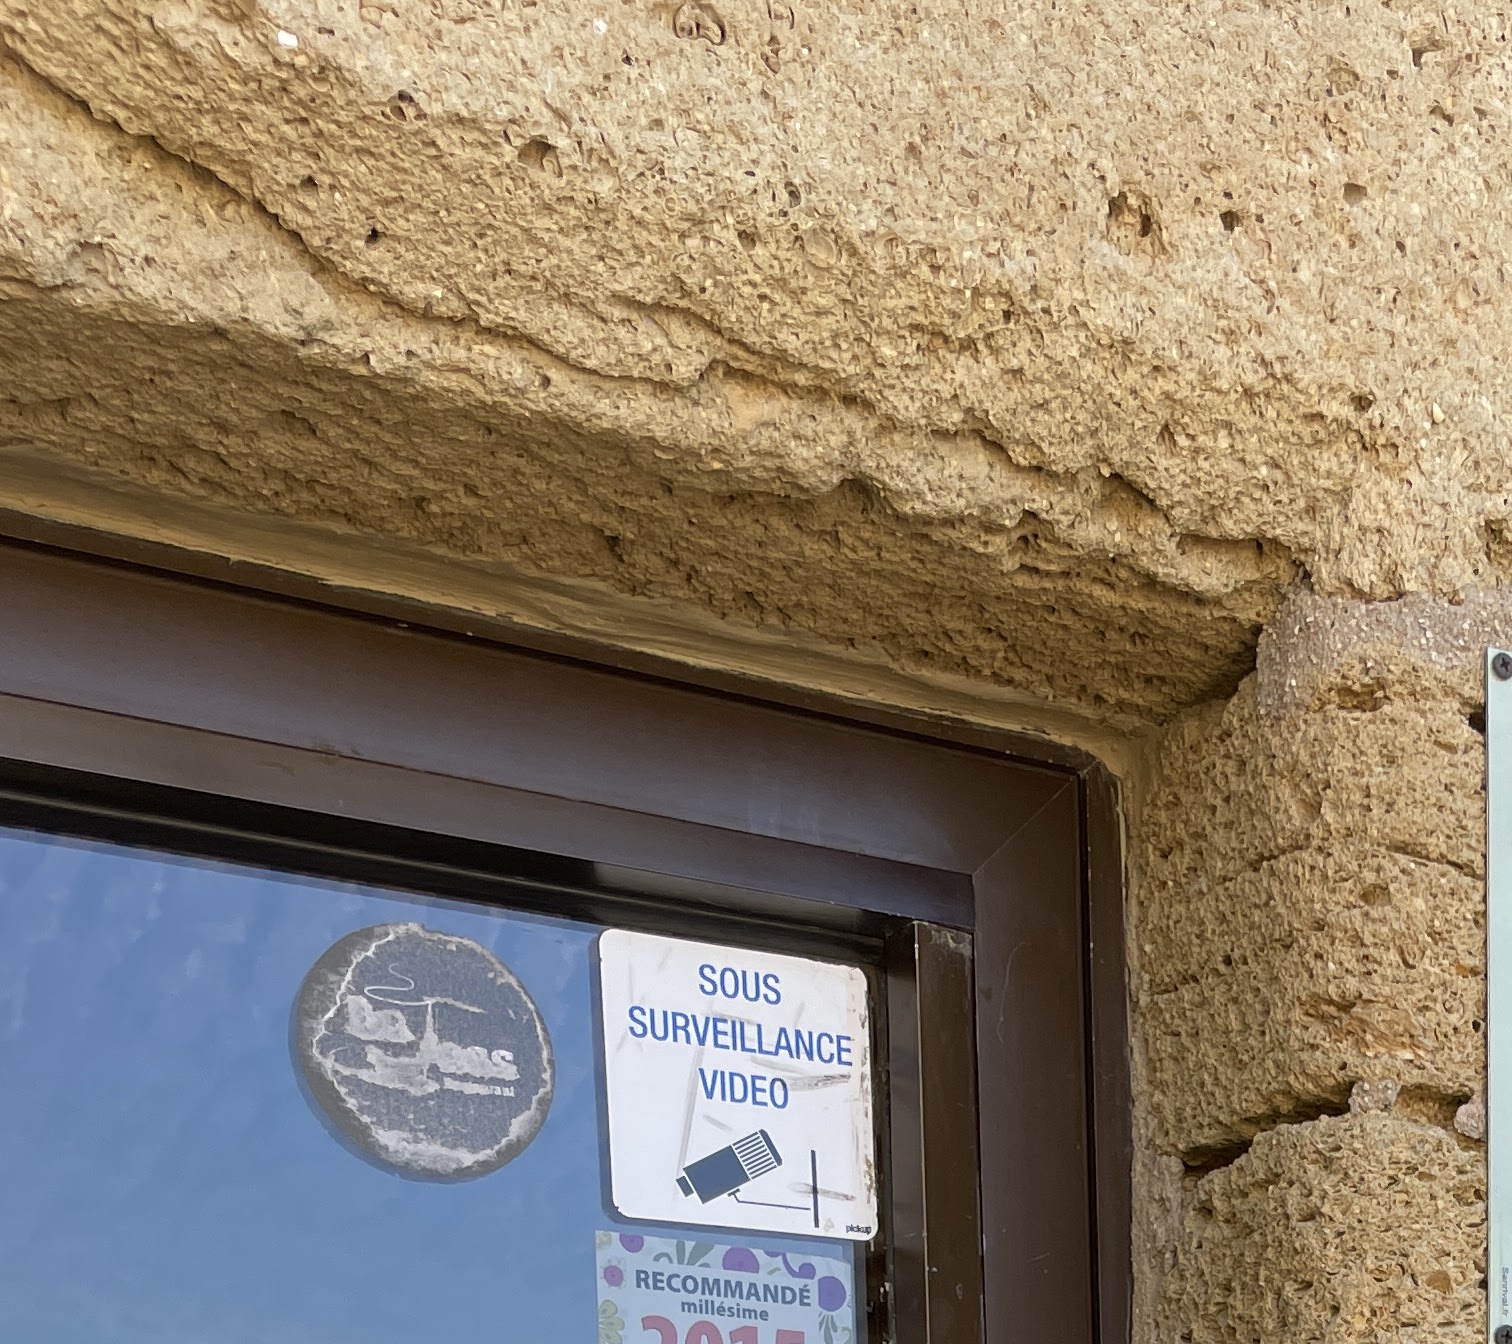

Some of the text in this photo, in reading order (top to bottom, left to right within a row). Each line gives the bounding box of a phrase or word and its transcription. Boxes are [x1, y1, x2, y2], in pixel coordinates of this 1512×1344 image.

[699, 963, 782, 1005] SOUS
[628, 1005, 853, 1067] SURVEILLANCE
[698, 1067, 789, 1109] VIDEO
[635, 1269, 812, 1307] RECOMMANDÉ
[681, 1299, 769, 1322] millésime
